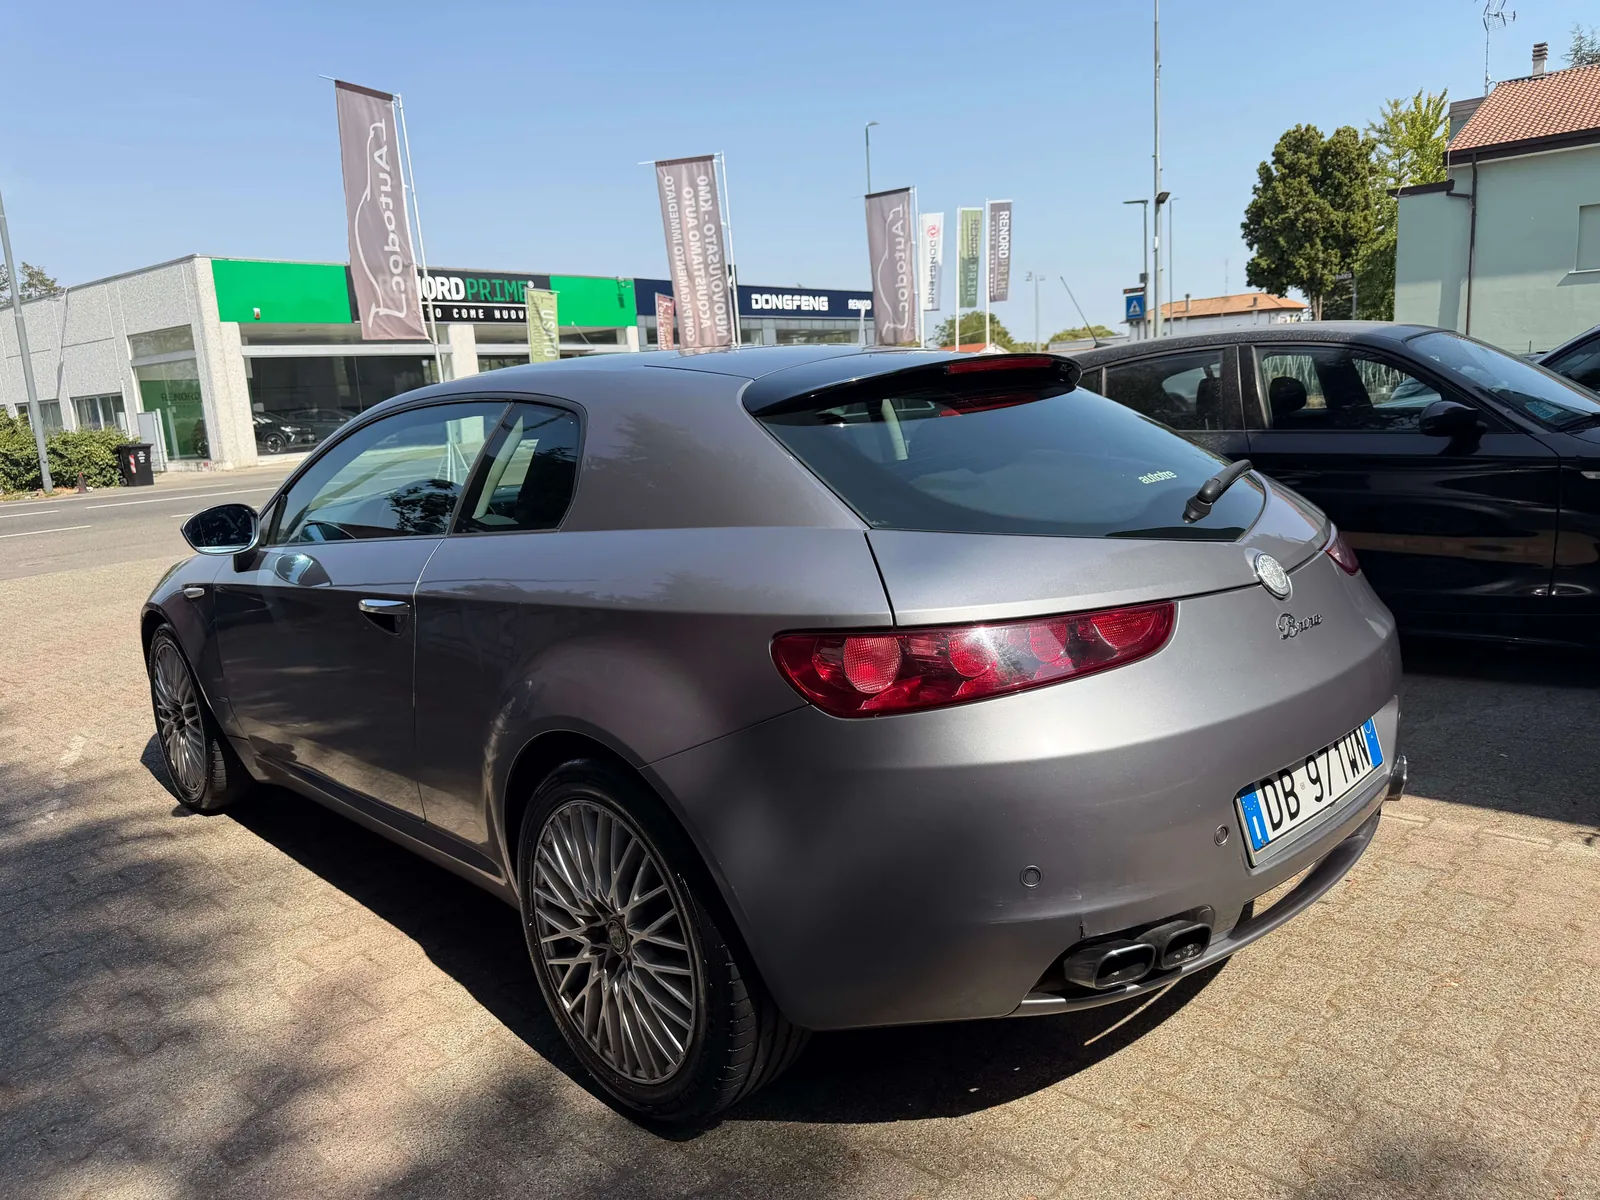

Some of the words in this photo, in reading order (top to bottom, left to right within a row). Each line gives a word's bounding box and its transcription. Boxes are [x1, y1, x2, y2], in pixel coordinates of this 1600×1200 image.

[452, 308, 485, 319] COME
[493, 309, 527, 319] NUOV
[751, 293, 828, 311] DONGFENG
[1276, 612, 1323, 640] Brera
[1260, 768, 1301, 832] DB
